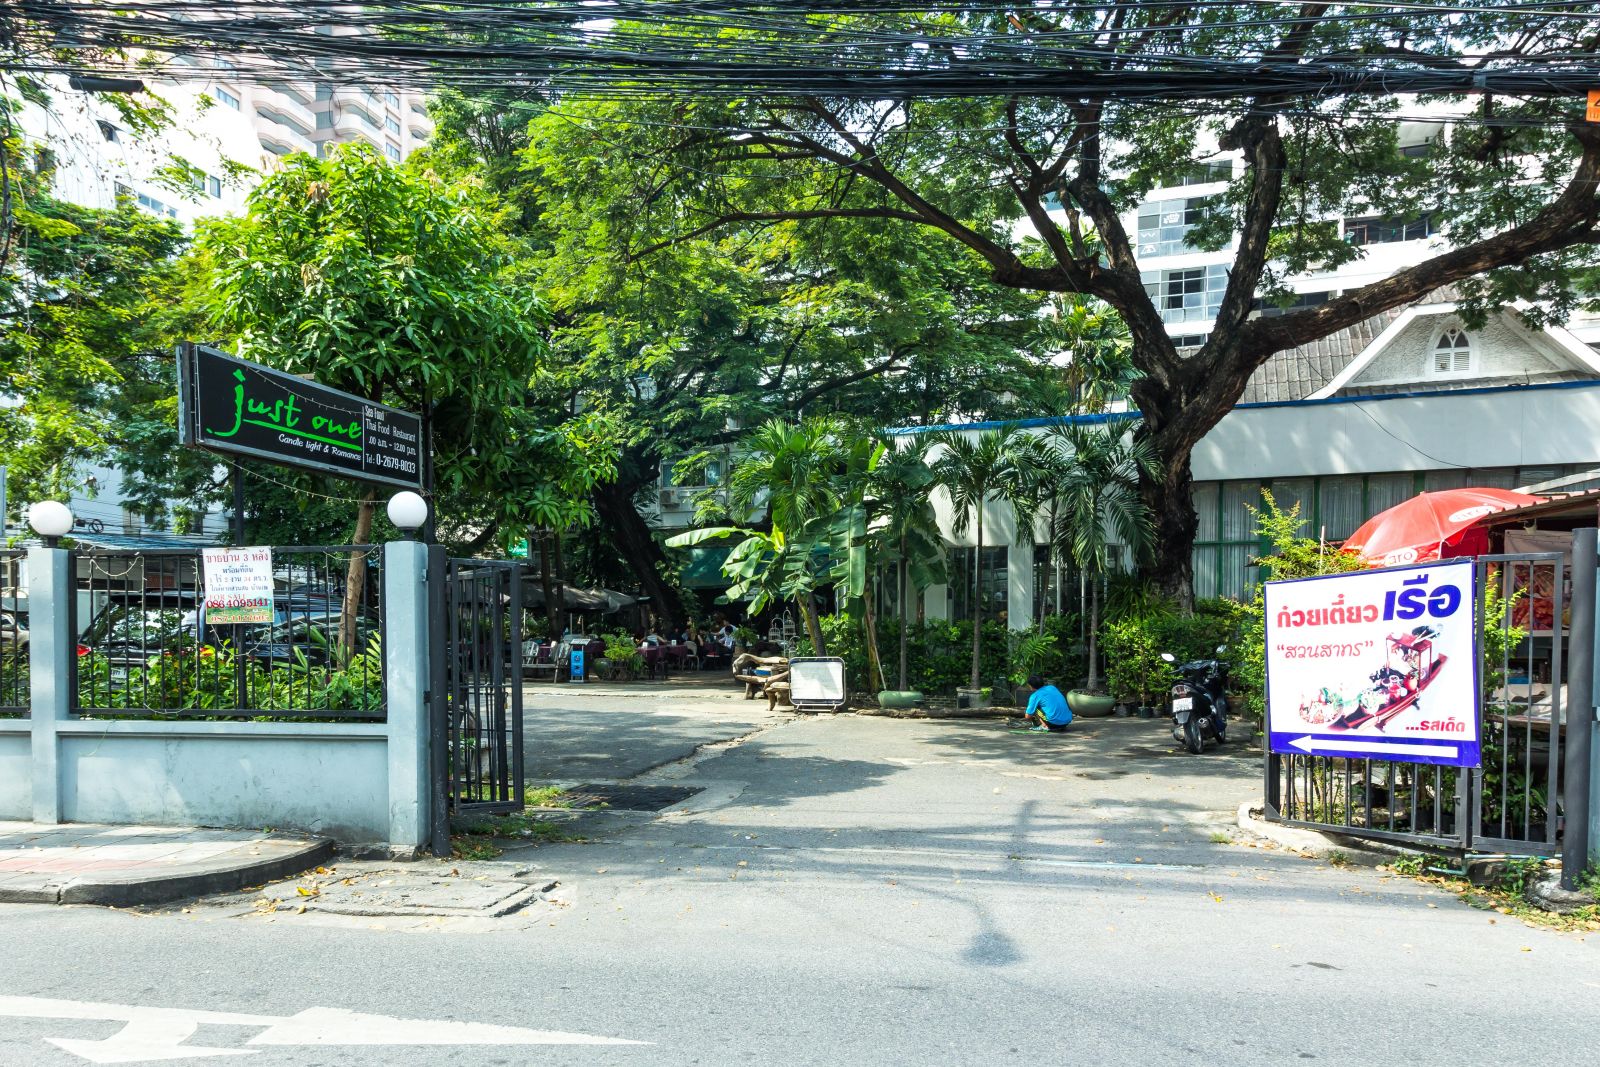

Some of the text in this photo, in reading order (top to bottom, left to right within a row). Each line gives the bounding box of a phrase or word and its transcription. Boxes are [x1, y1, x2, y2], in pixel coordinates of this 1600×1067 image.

[206, 369, 362, 439] just one
[365, 418, 416, 442] Thai Food Restaurant
[278, 433, 362, 460] Candle light & Romance
[376, 453, 416, 474] 0-2679-8033
[243, 553, 249, 562] 3
[252, 549, 269, 561] หลัง
[1277, 573, 1462, 628] ก๋วยเตี๋ยว เรือ
